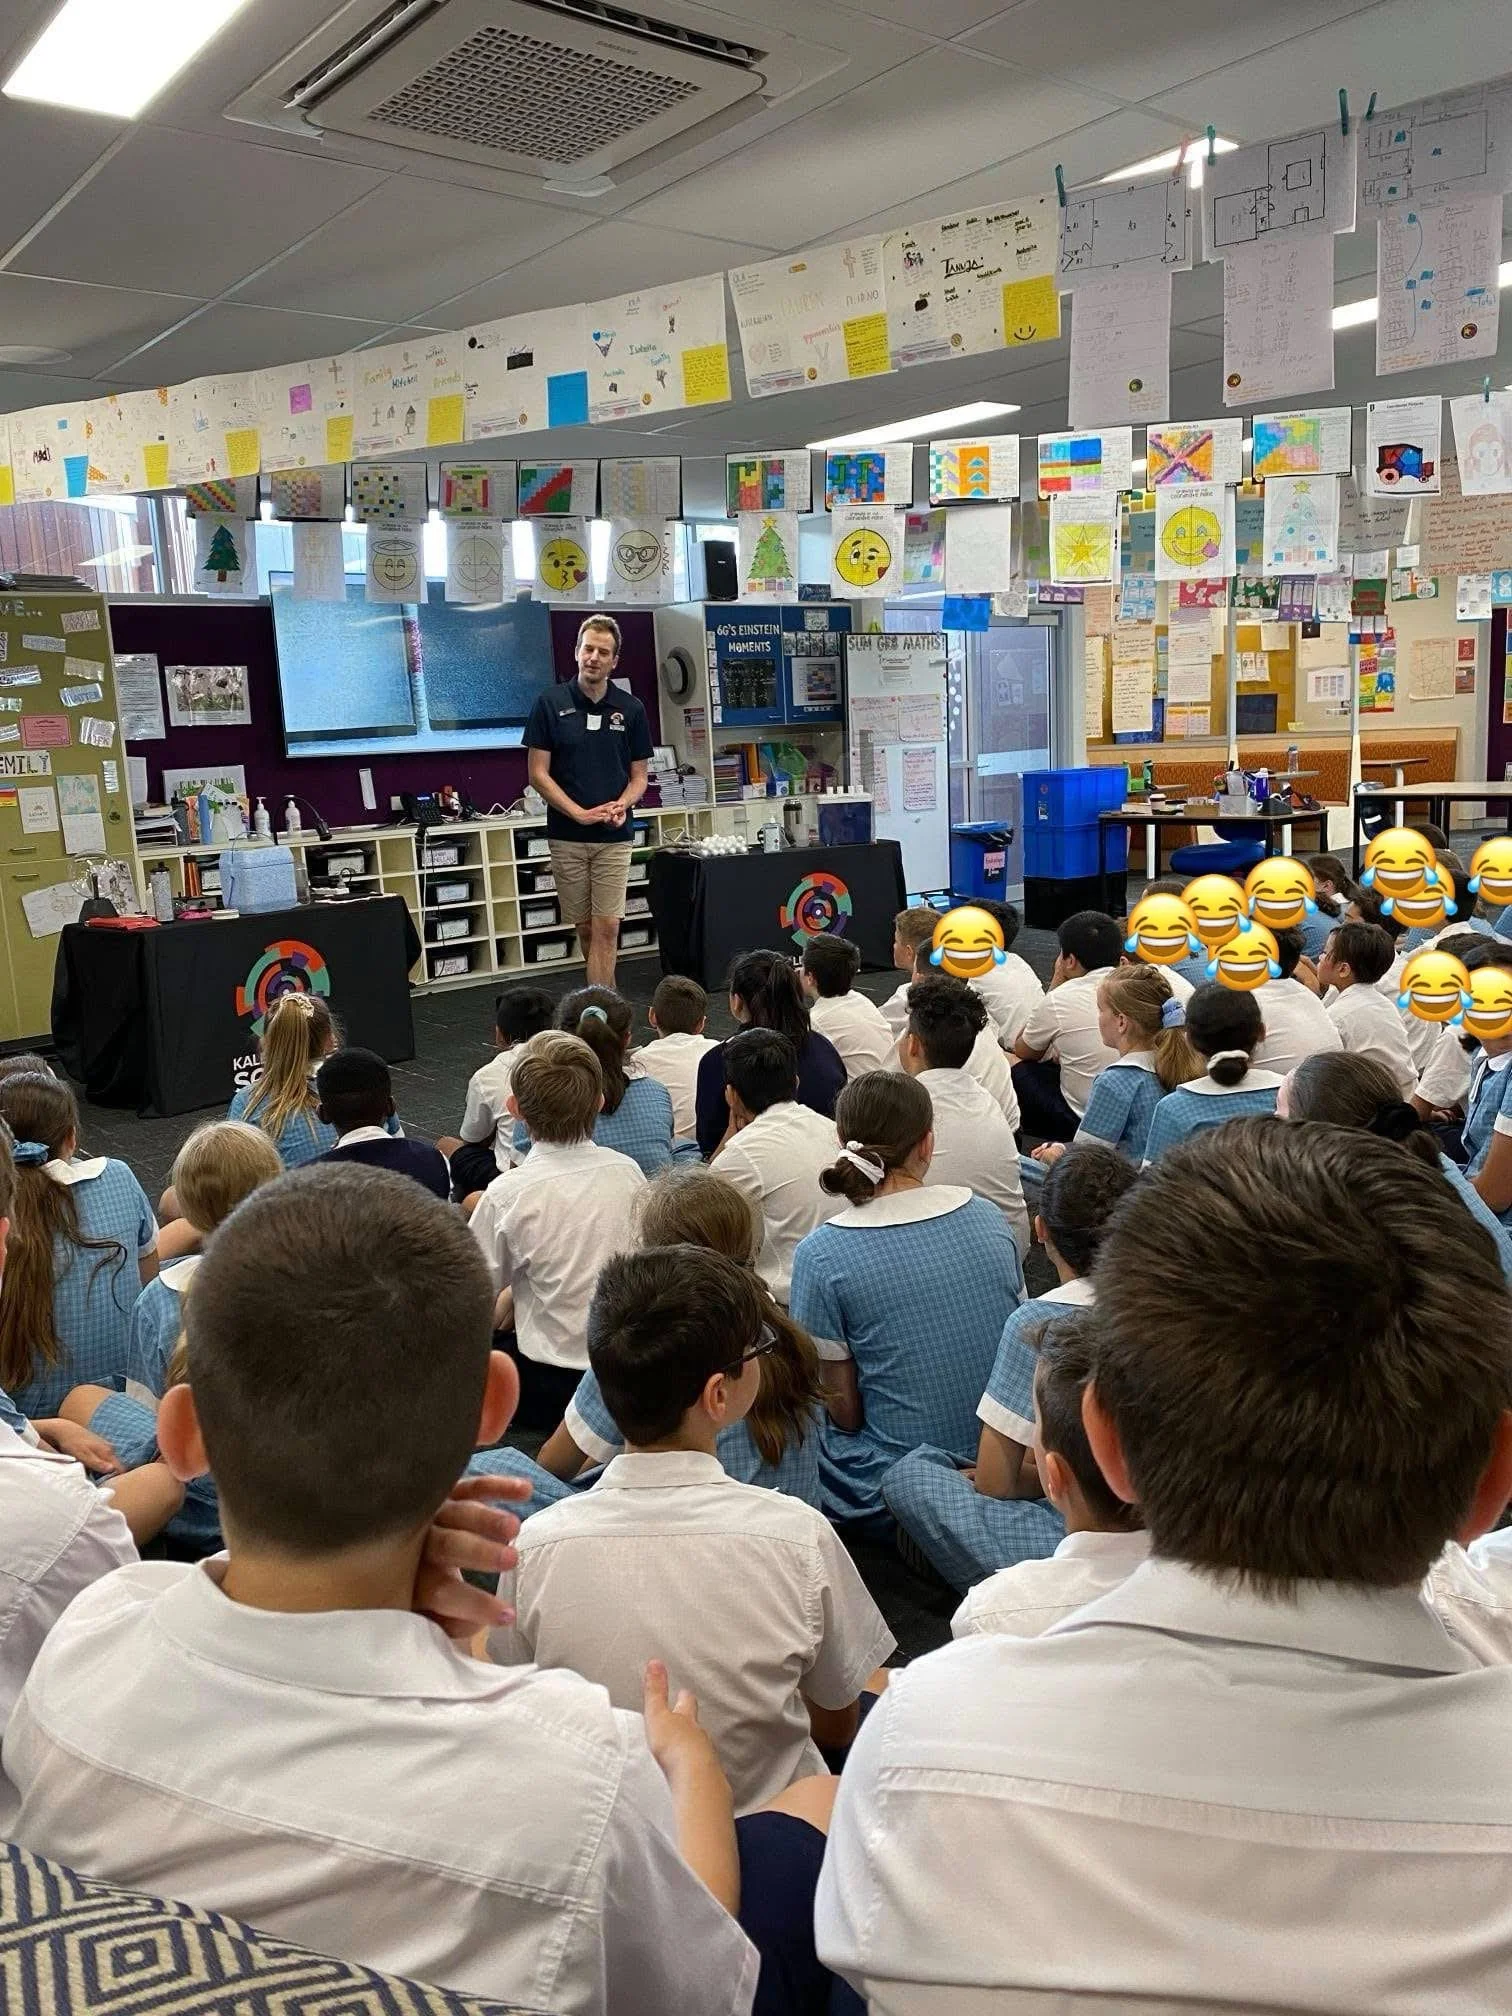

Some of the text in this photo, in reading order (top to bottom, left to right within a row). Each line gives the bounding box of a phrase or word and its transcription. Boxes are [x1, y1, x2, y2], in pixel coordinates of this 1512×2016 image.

[738, 624, 780, 636] EINSTEIN
[728, 641, 772, 653] MOMENTS
[233, 1053, 265, 1071] KAL
